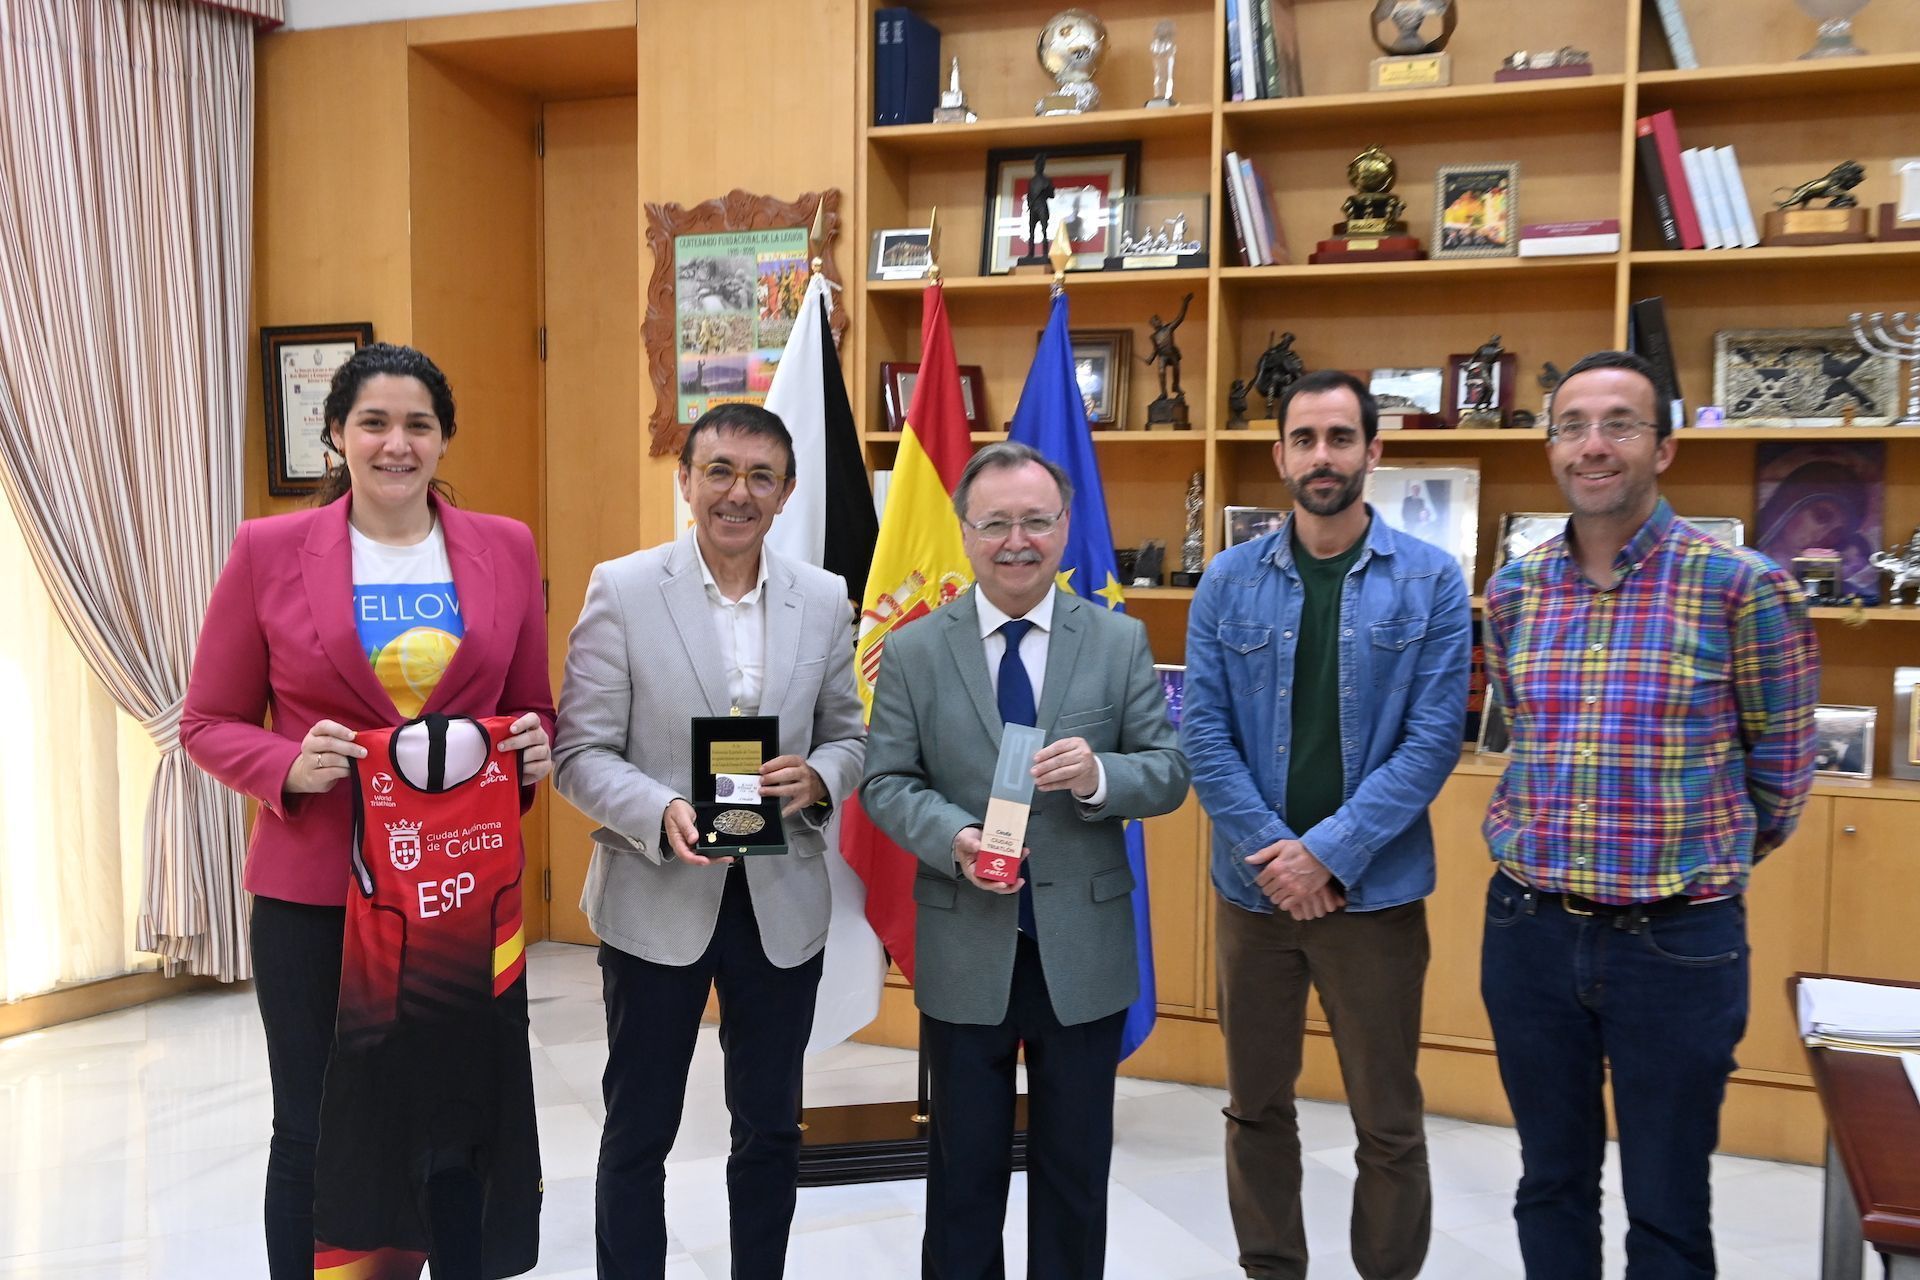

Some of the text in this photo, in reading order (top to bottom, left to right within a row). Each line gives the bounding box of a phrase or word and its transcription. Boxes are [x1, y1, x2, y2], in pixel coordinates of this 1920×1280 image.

[426, 829, 459, 842] Ciudad
[427, 832, 504, 858] de Ceuta
[417, 871, 475, 919] ESP
